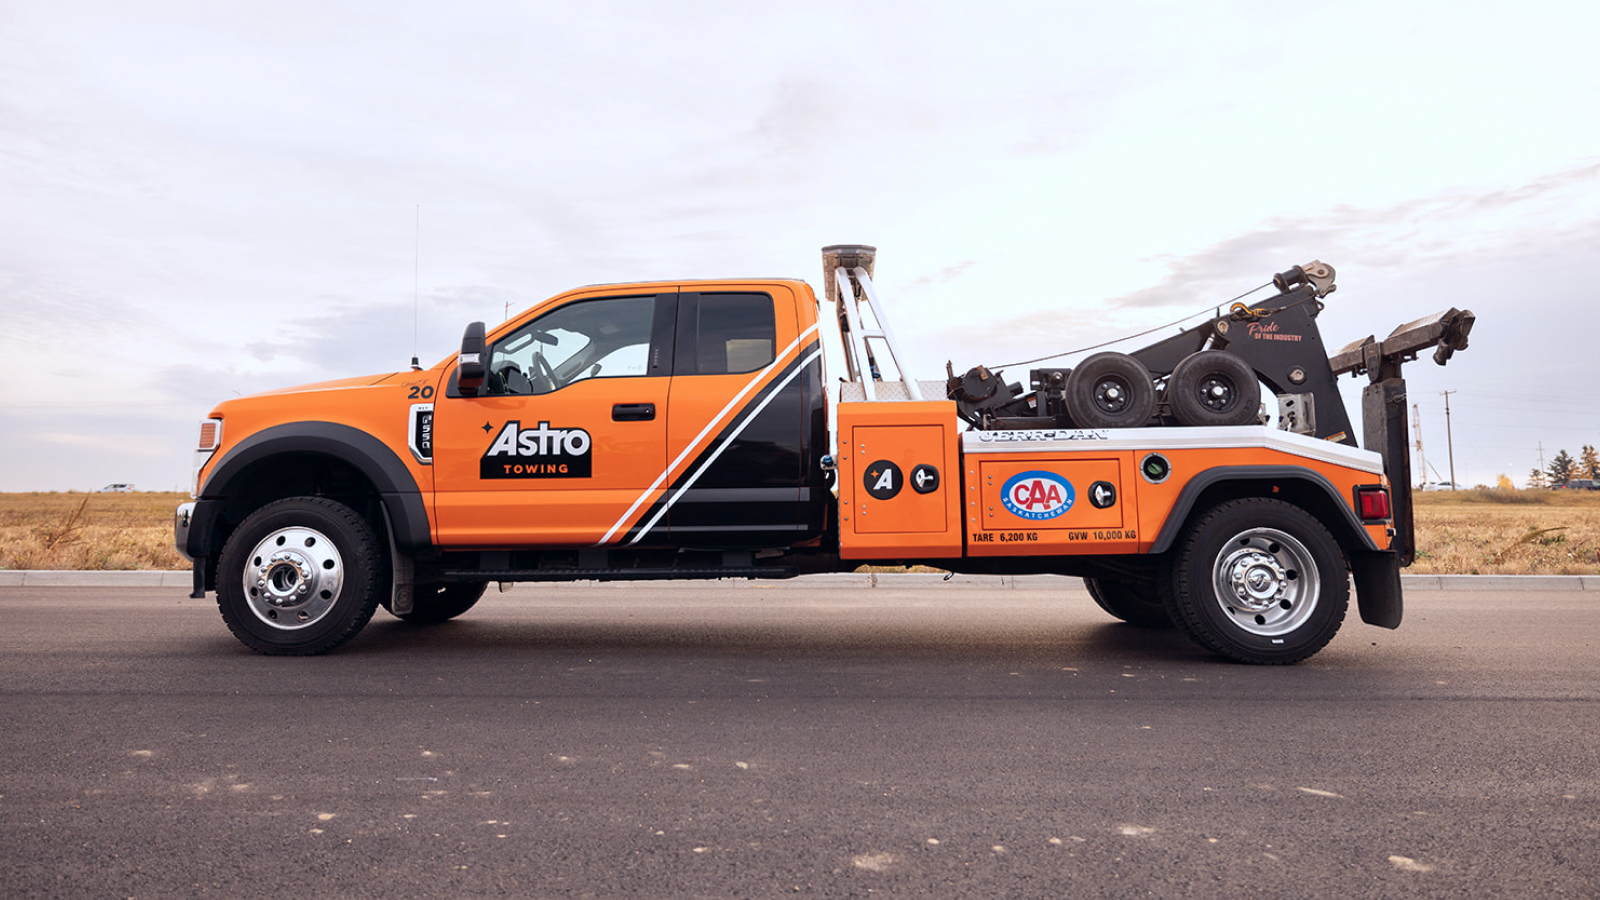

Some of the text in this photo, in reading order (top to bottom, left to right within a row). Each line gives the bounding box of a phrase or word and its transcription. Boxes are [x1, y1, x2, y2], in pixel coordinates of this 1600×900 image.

[1246, 321, 1280, 335] Pride
[408, 386, 434, 399] 20
[487, 422, 590, 456] Astro
[503, 464, 569, 474] TOWING
[873, 468, 893, 490] A
[1014, 480, 1062, 510] CAA
[1002, 497, 1073, 519] SASKATCHEWAN
[972, 532, 1038, 542] TARE 6,200 KG
[1068, 530, 1136, 540] GVW 10,000 KG
